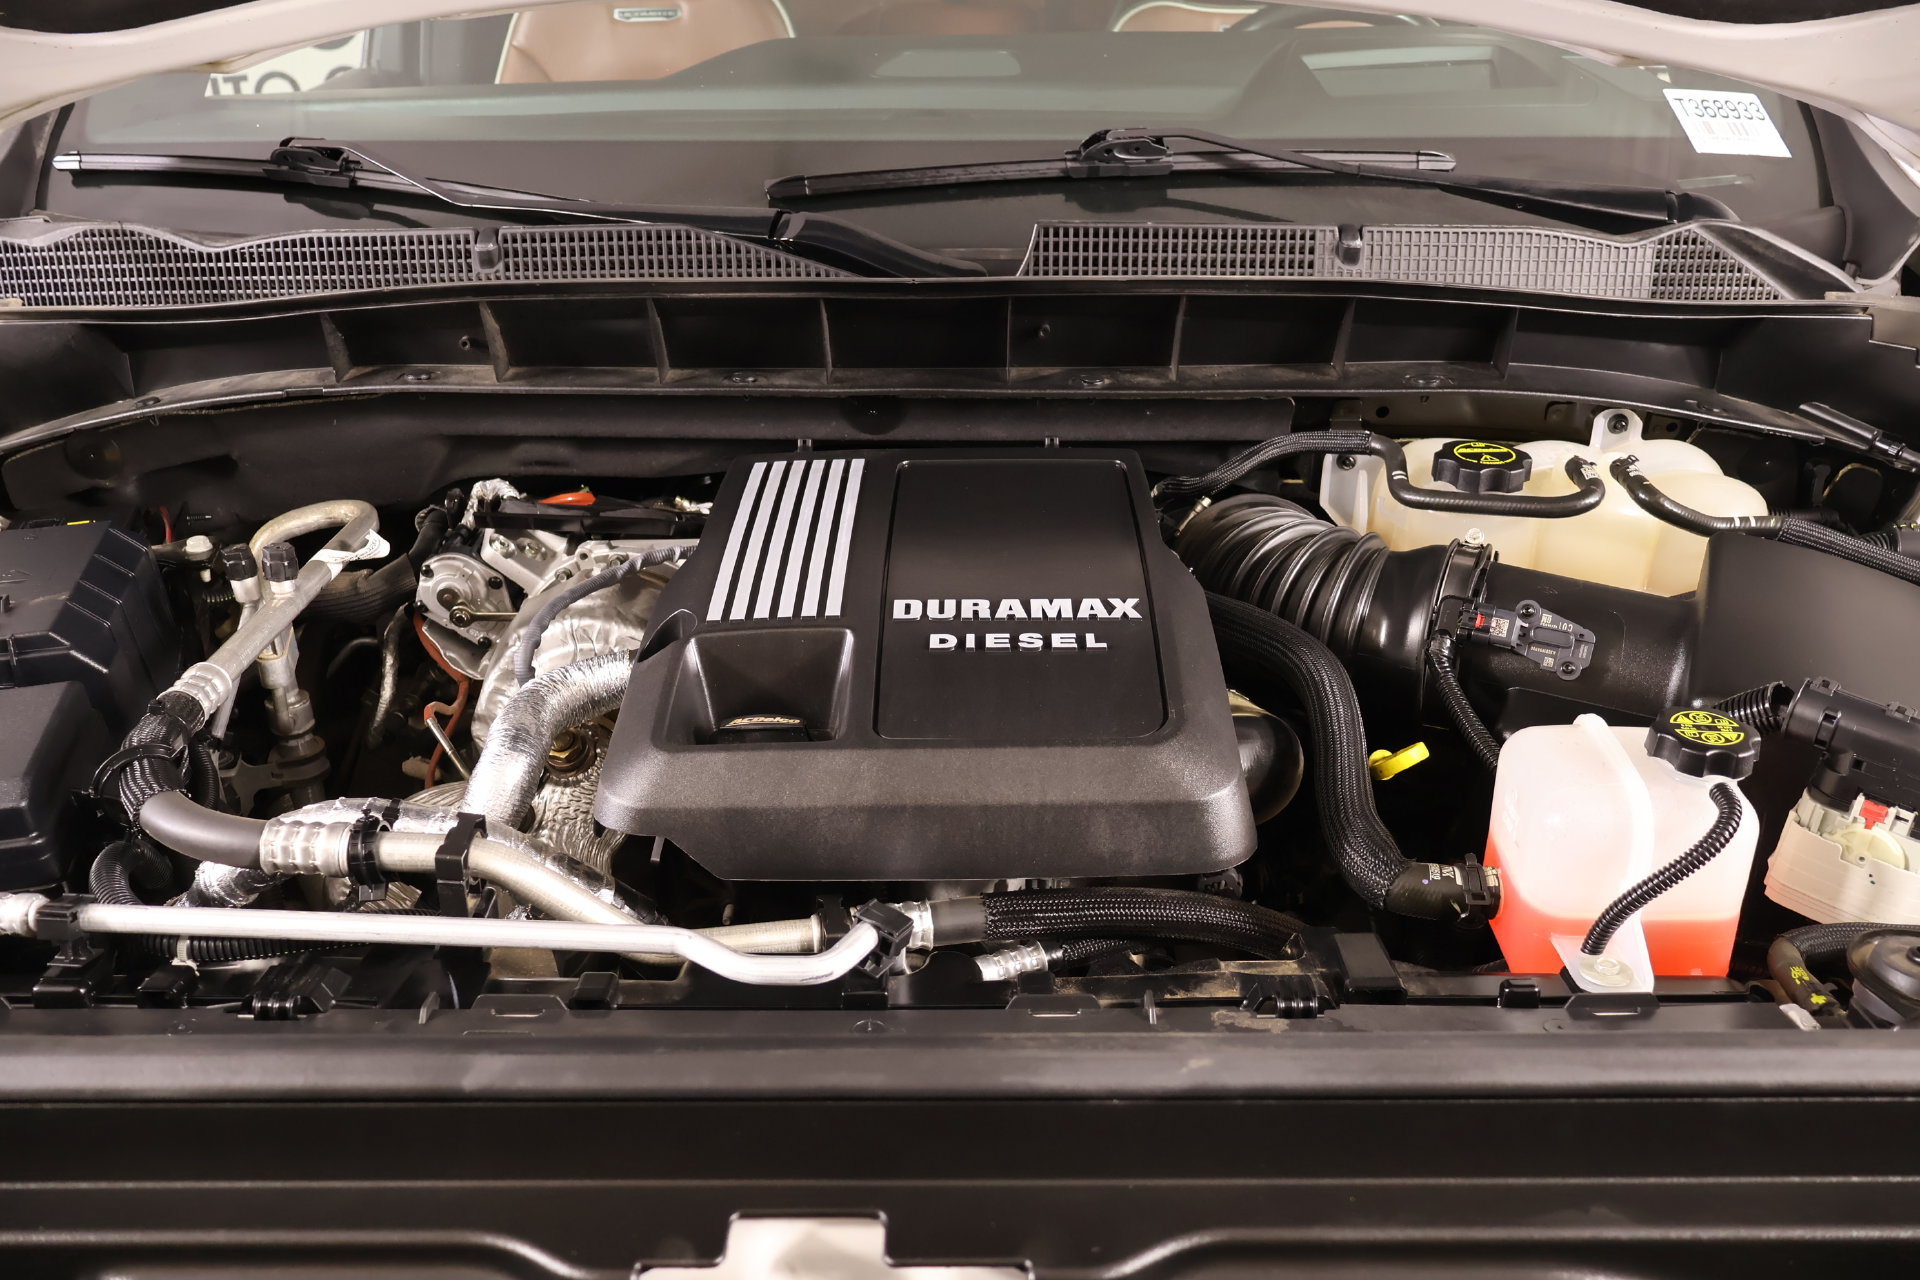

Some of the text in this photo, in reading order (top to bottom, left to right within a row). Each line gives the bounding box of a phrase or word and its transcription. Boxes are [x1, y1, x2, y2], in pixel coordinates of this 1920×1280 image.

[1673, 98, 1766, 121] T368933
[892, 598, 1143, 621] DURAMAX
[928, 632, 1109, 652] DIESEL
